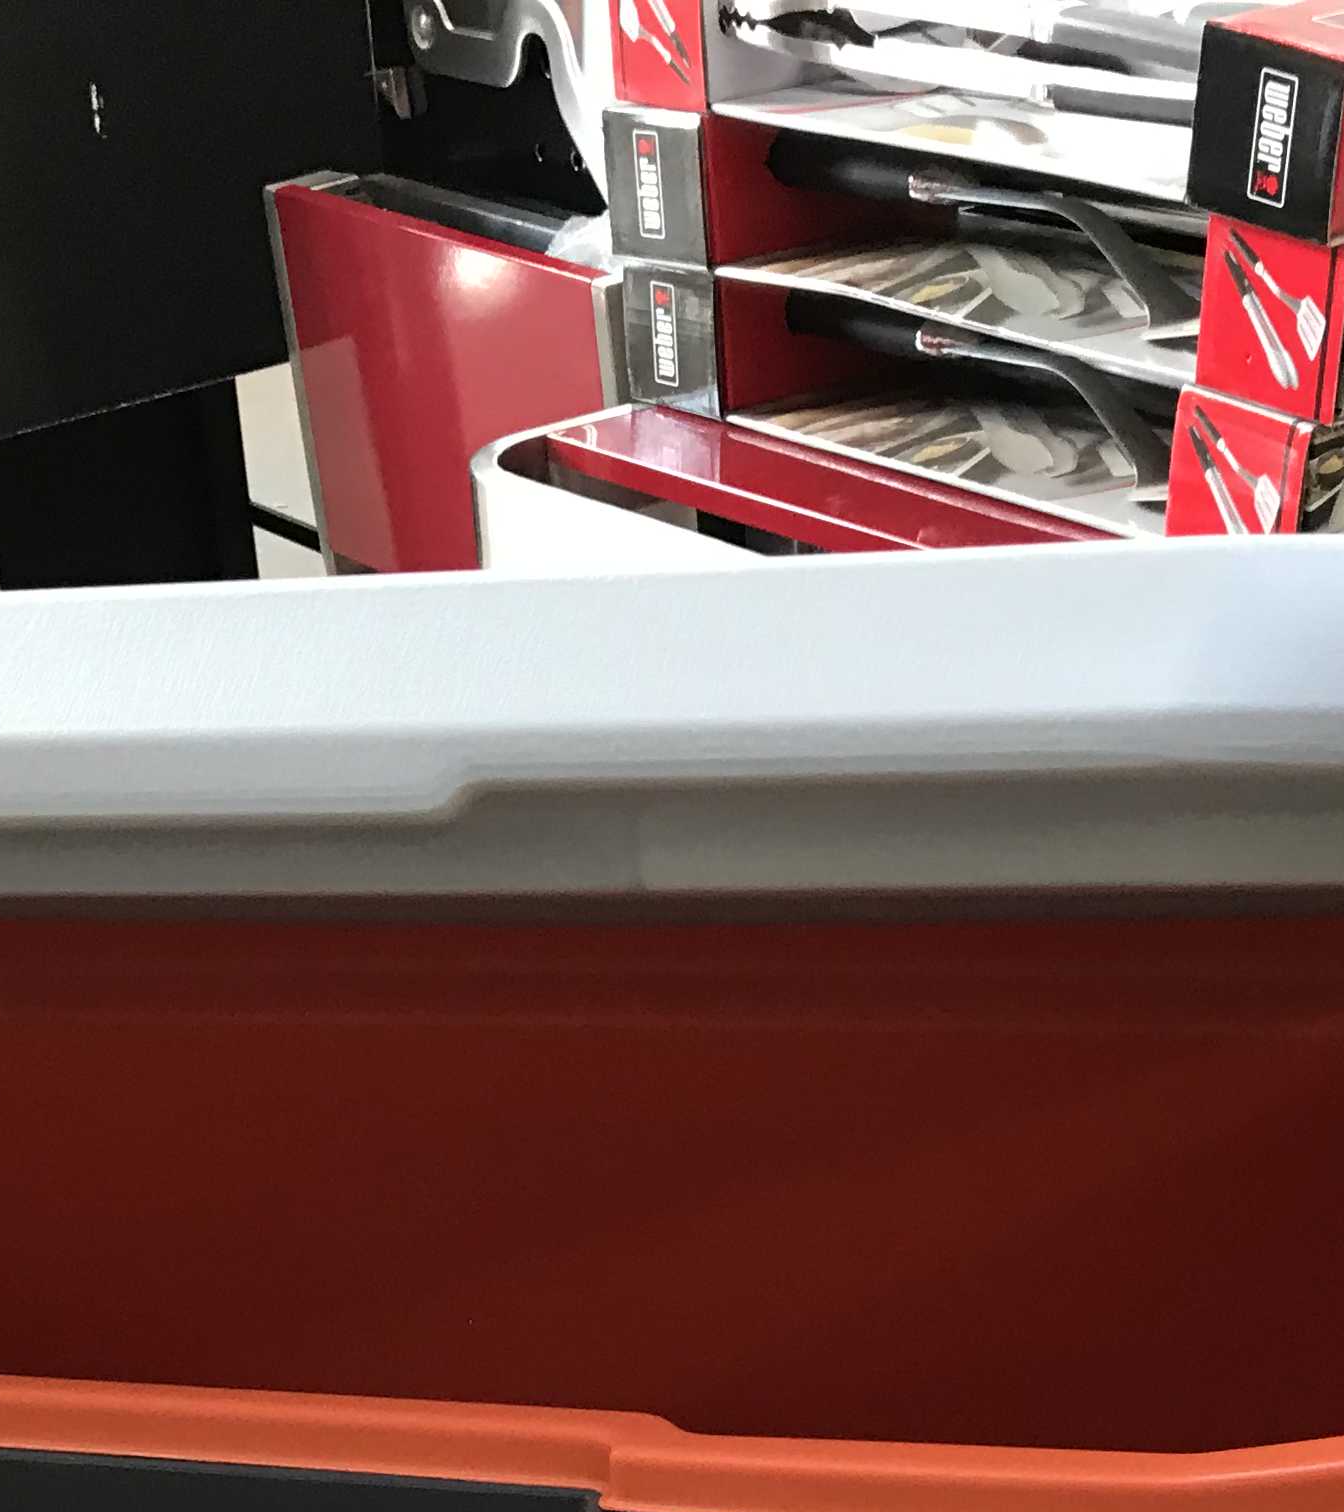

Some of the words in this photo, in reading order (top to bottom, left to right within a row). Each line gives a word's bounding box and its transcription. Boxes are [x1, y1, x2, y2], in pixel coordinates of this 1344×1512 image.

[1256, 80, 1292, 173] weber
[639, 156, 661, 230] weber
[656, 307, 675, 378] weber
